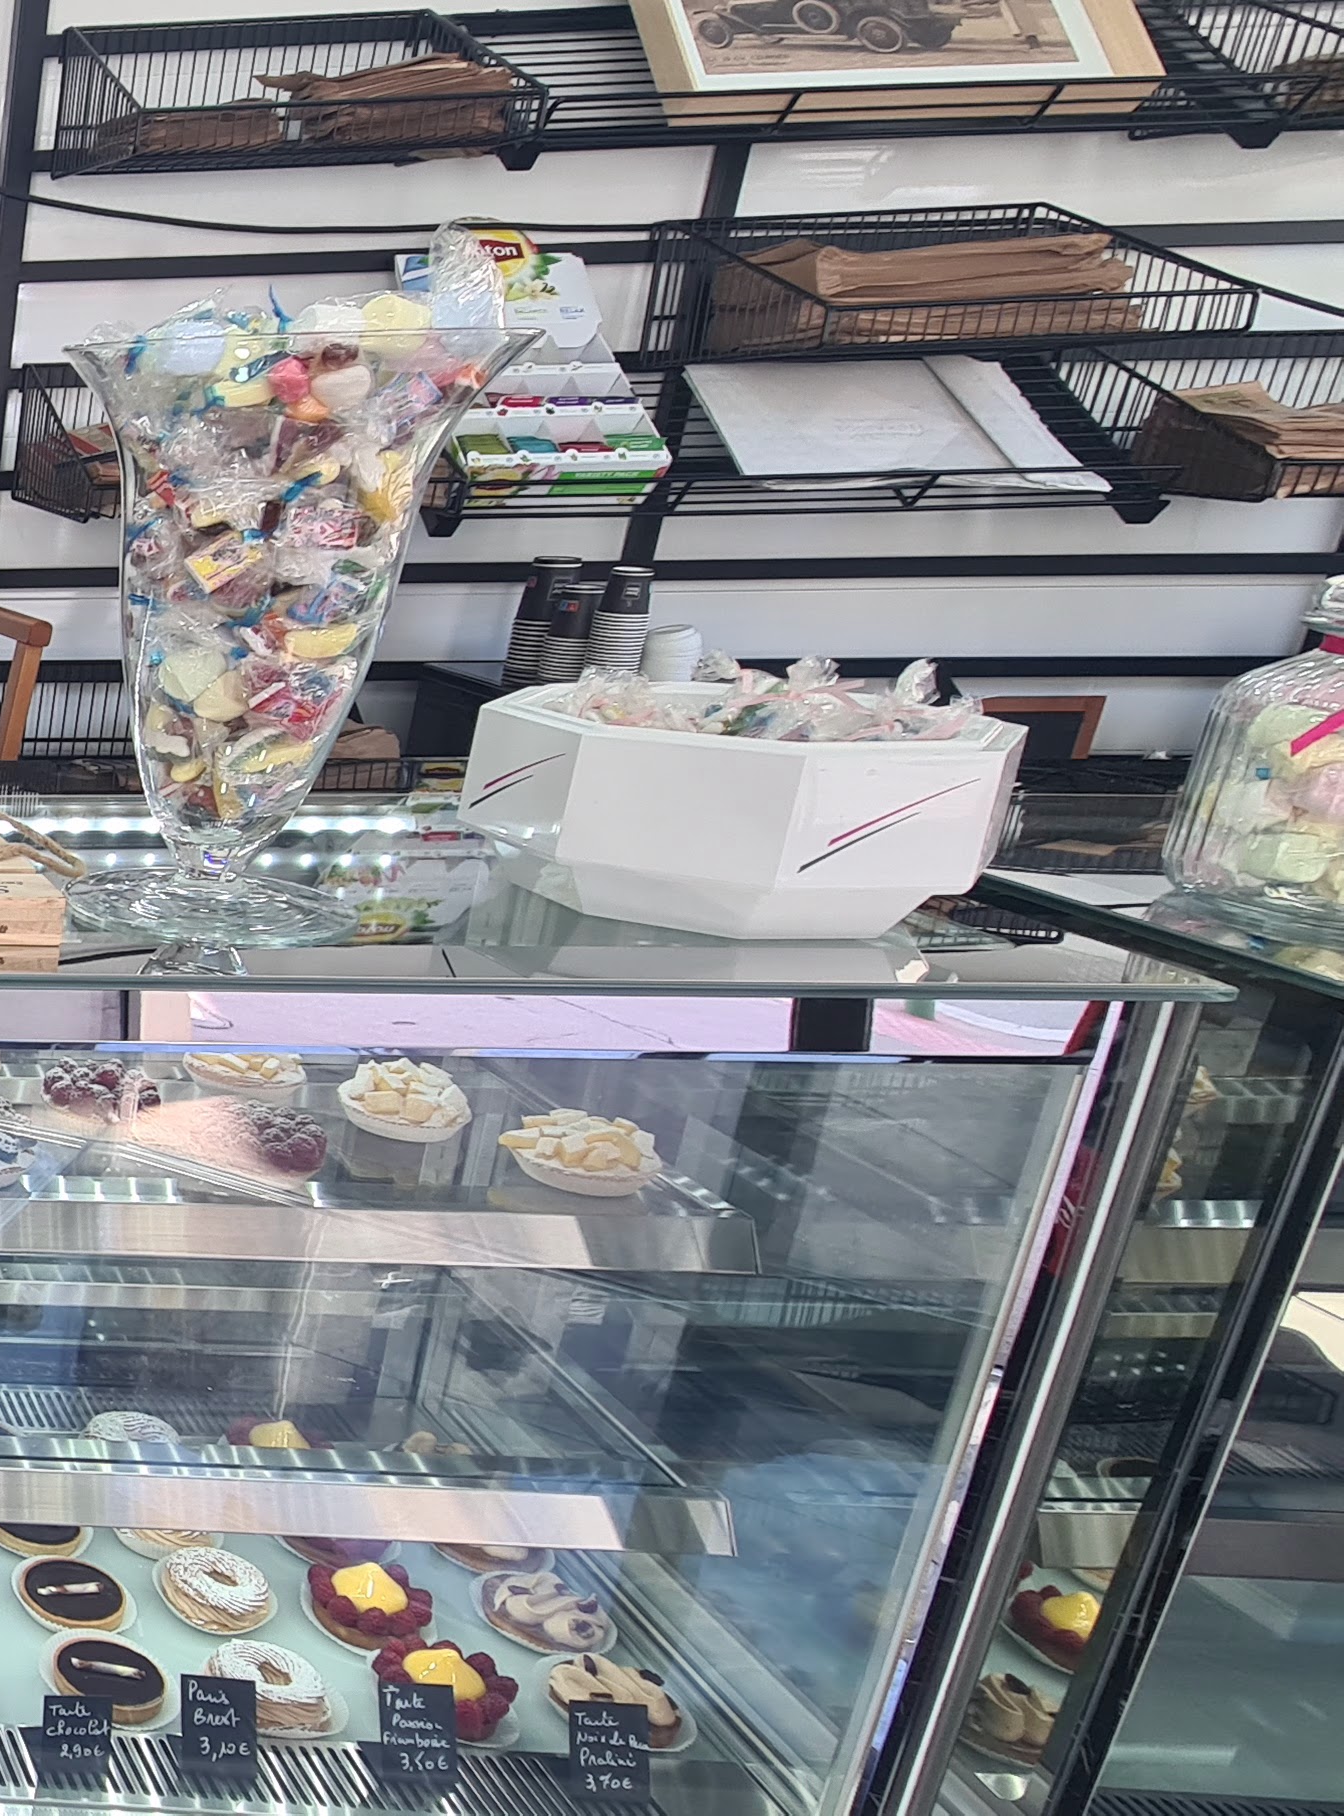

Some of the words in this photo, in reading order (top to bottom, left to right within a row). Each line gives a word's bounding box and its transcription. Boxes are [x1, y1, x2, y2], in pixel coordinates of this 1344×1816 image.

[188, 1679, 231, 1705] Paris
[382, 1685, 426, 1710] Tarte
[48, 1701, 92, 1718] Tarte
[193, 1707, 241, 1728] Brest
[392, 1713, 443, 1730] Passion
[574, 1710, 619, 1727] Tarte
[576, 1730, 606, 1745] Noix
[608, 1730, 626, 1746] de
[59, 1743, 105, 1760] 2,90€
[585, 1772, 633, 1793] 3,70€
